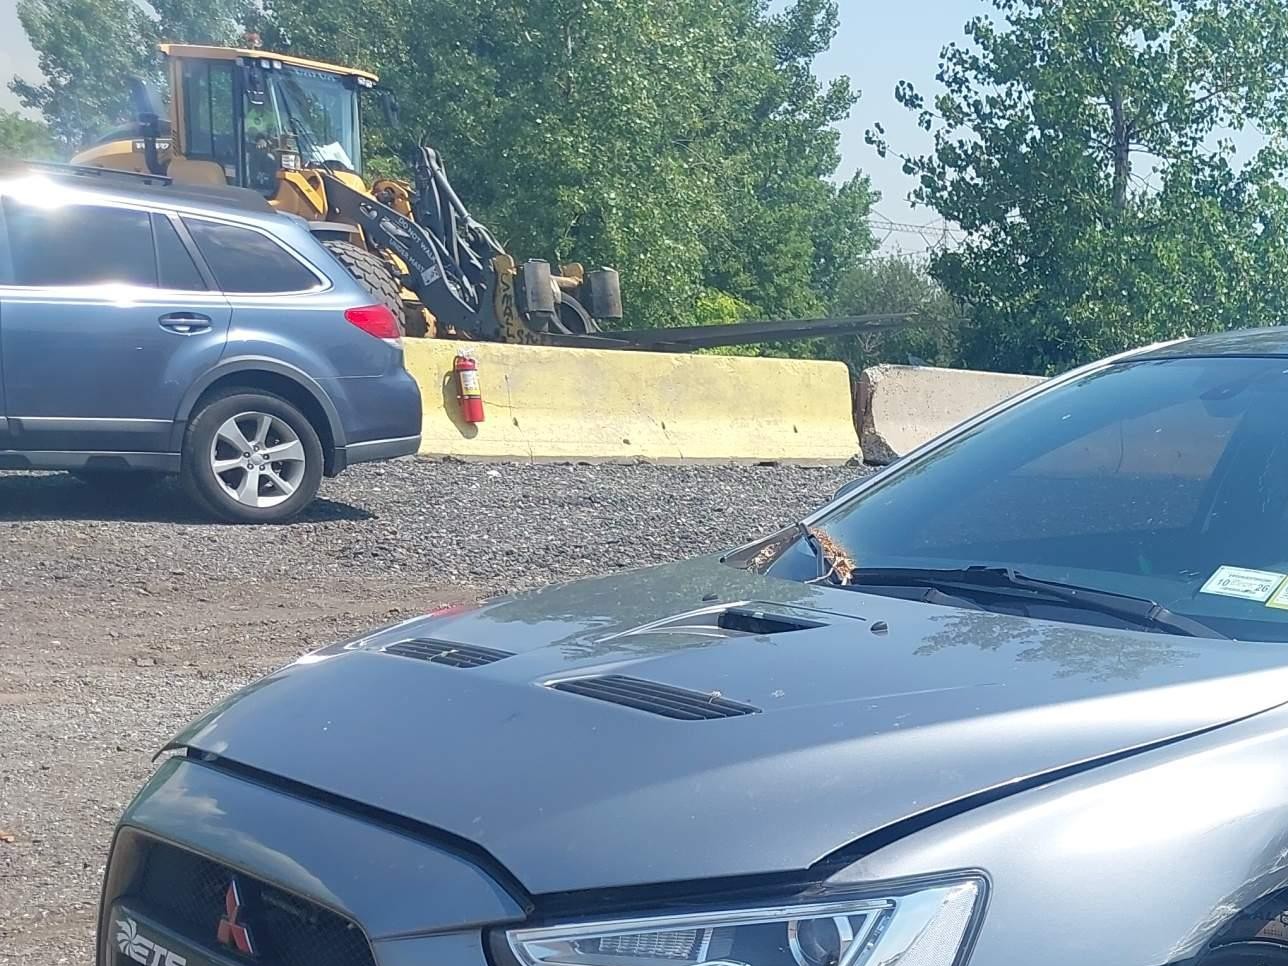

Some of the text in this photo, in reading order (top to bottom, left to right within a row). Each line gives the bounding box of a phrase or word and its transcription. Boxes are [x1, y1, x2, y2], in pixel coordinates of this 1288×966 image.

[389, 238, 409, 260] UNDER
[398, 216, 437, 263] DO NOT WALK
